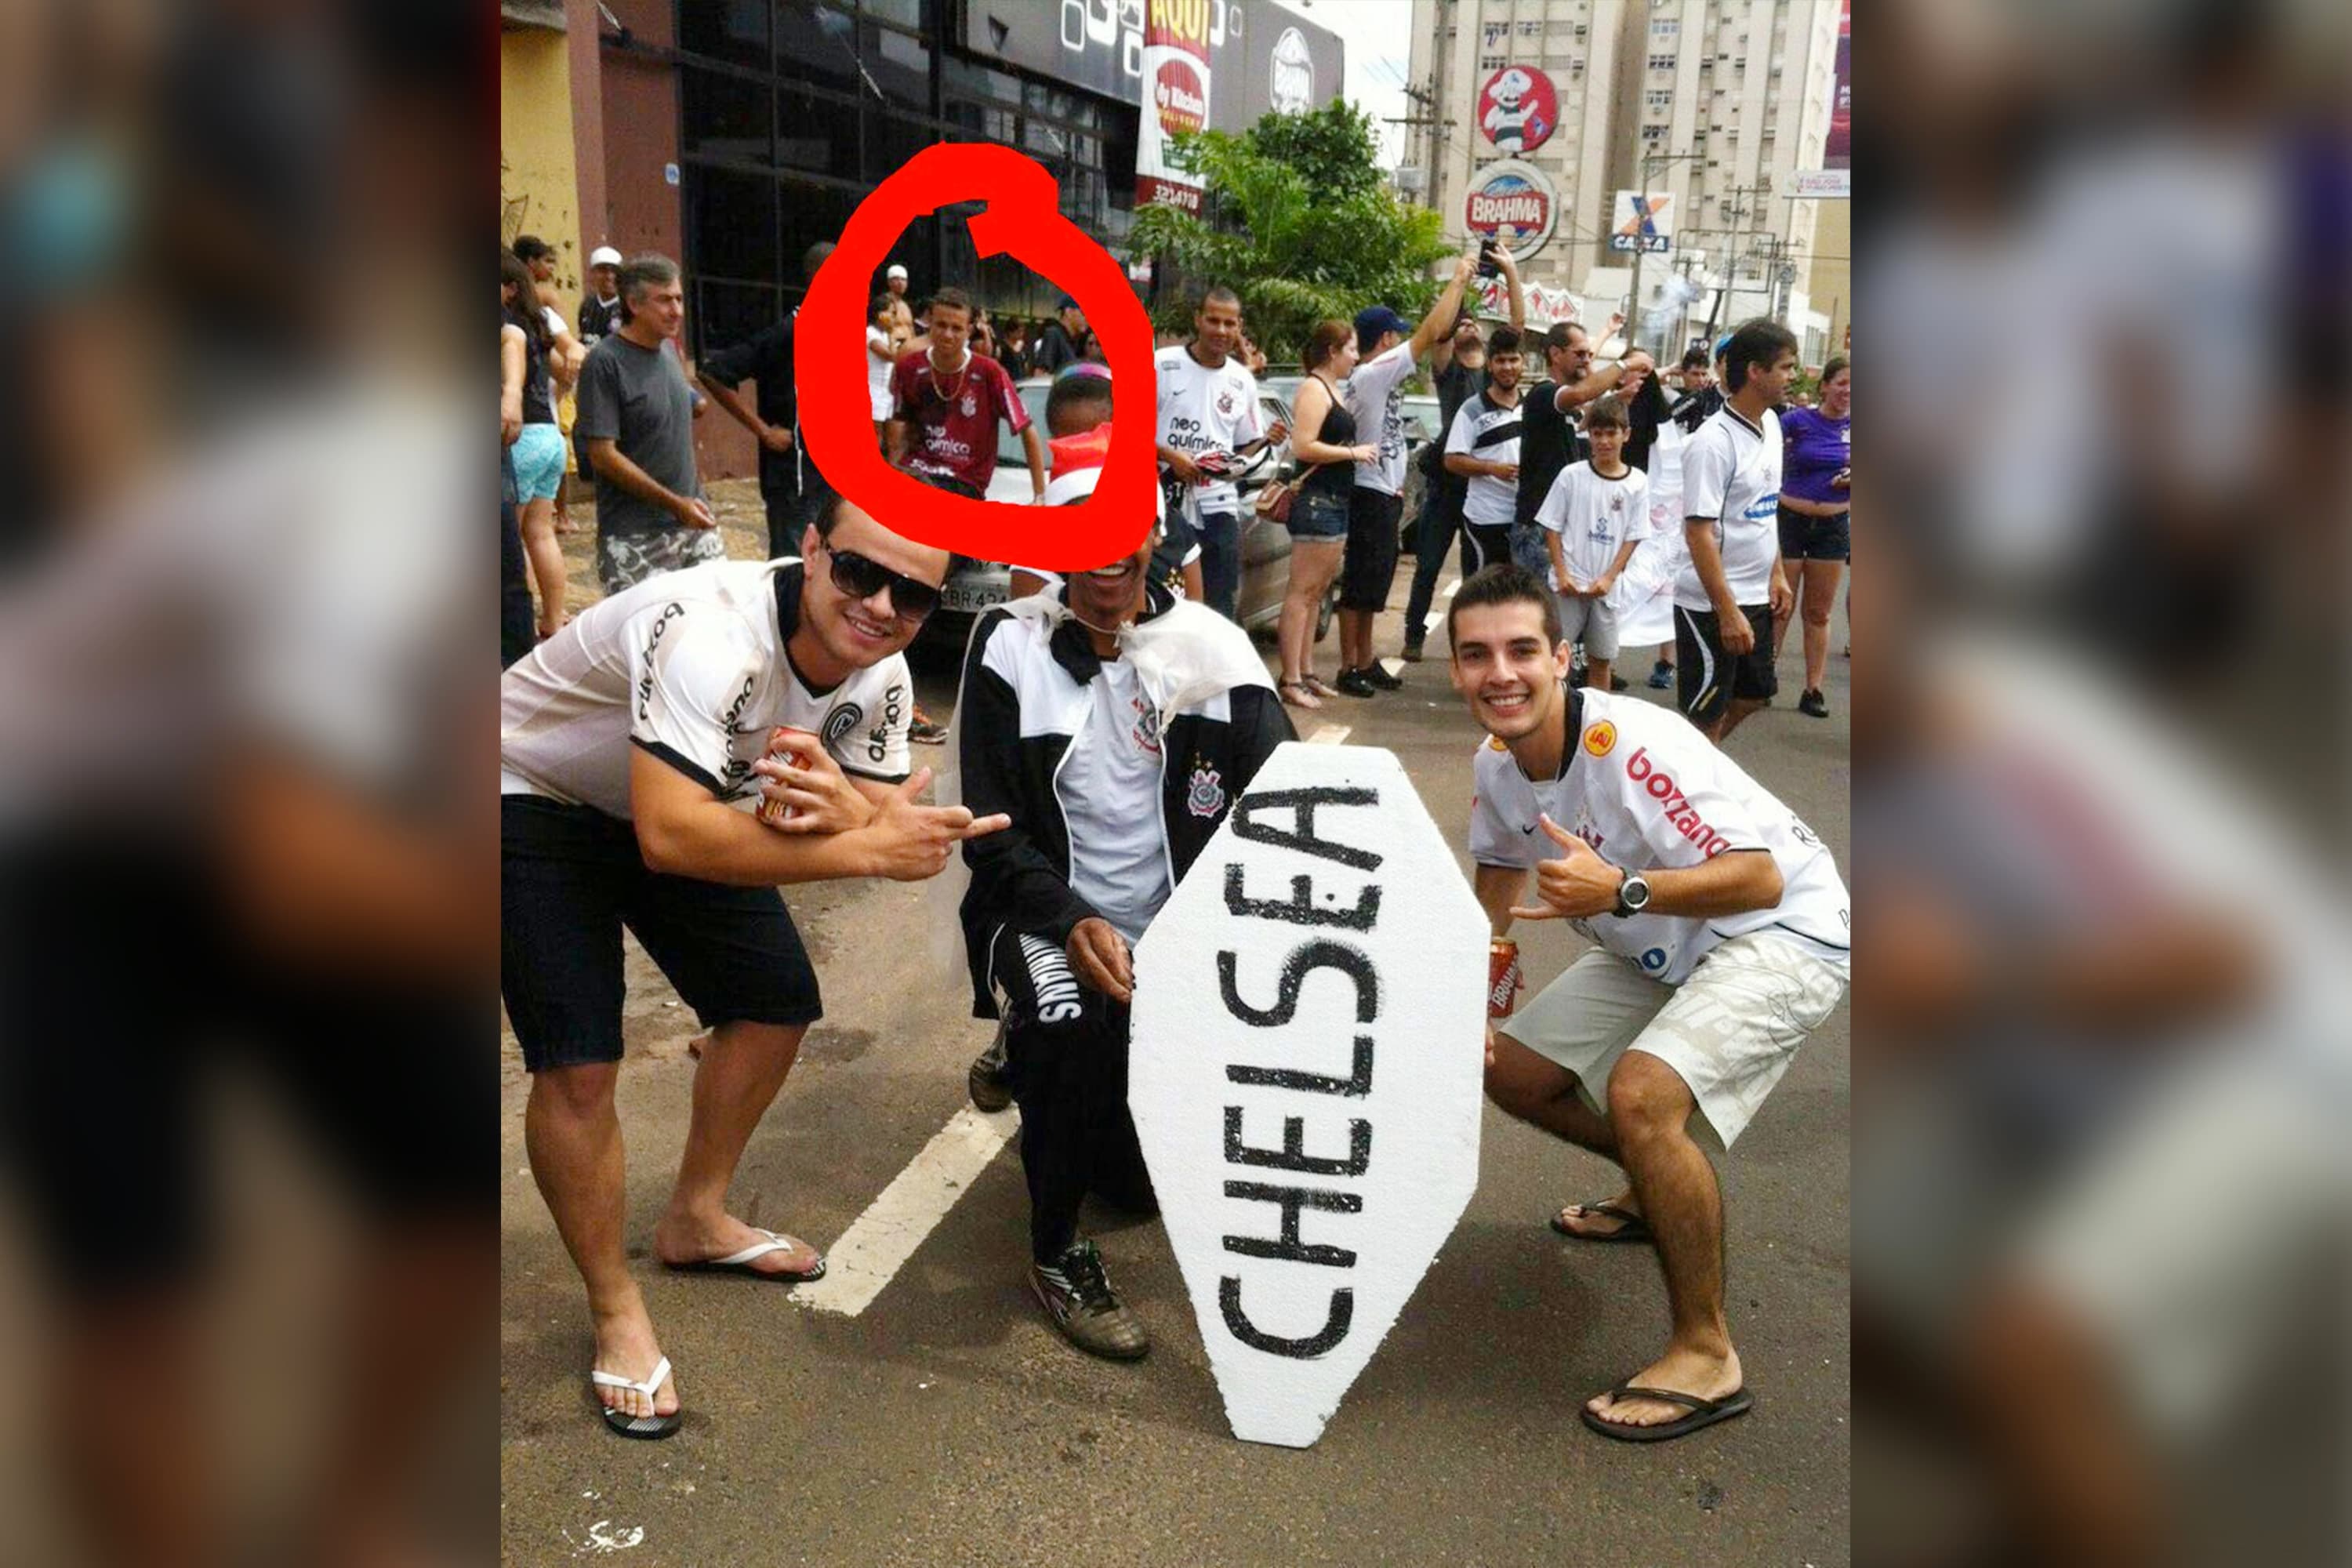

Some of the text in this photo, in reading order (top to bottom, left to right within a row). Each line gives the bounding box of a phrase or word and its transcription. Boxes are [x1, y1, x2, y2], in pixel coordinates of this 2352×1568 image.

[1150, 0, 1210, 48] AQUI
[1472, 195, 1542, 224] BRAHMA
[1614, 236, 1666, 250] CAXA
[1170, 416, 1201, 433] neo
[1216, 785, 1385, 1360] CHELSEA
